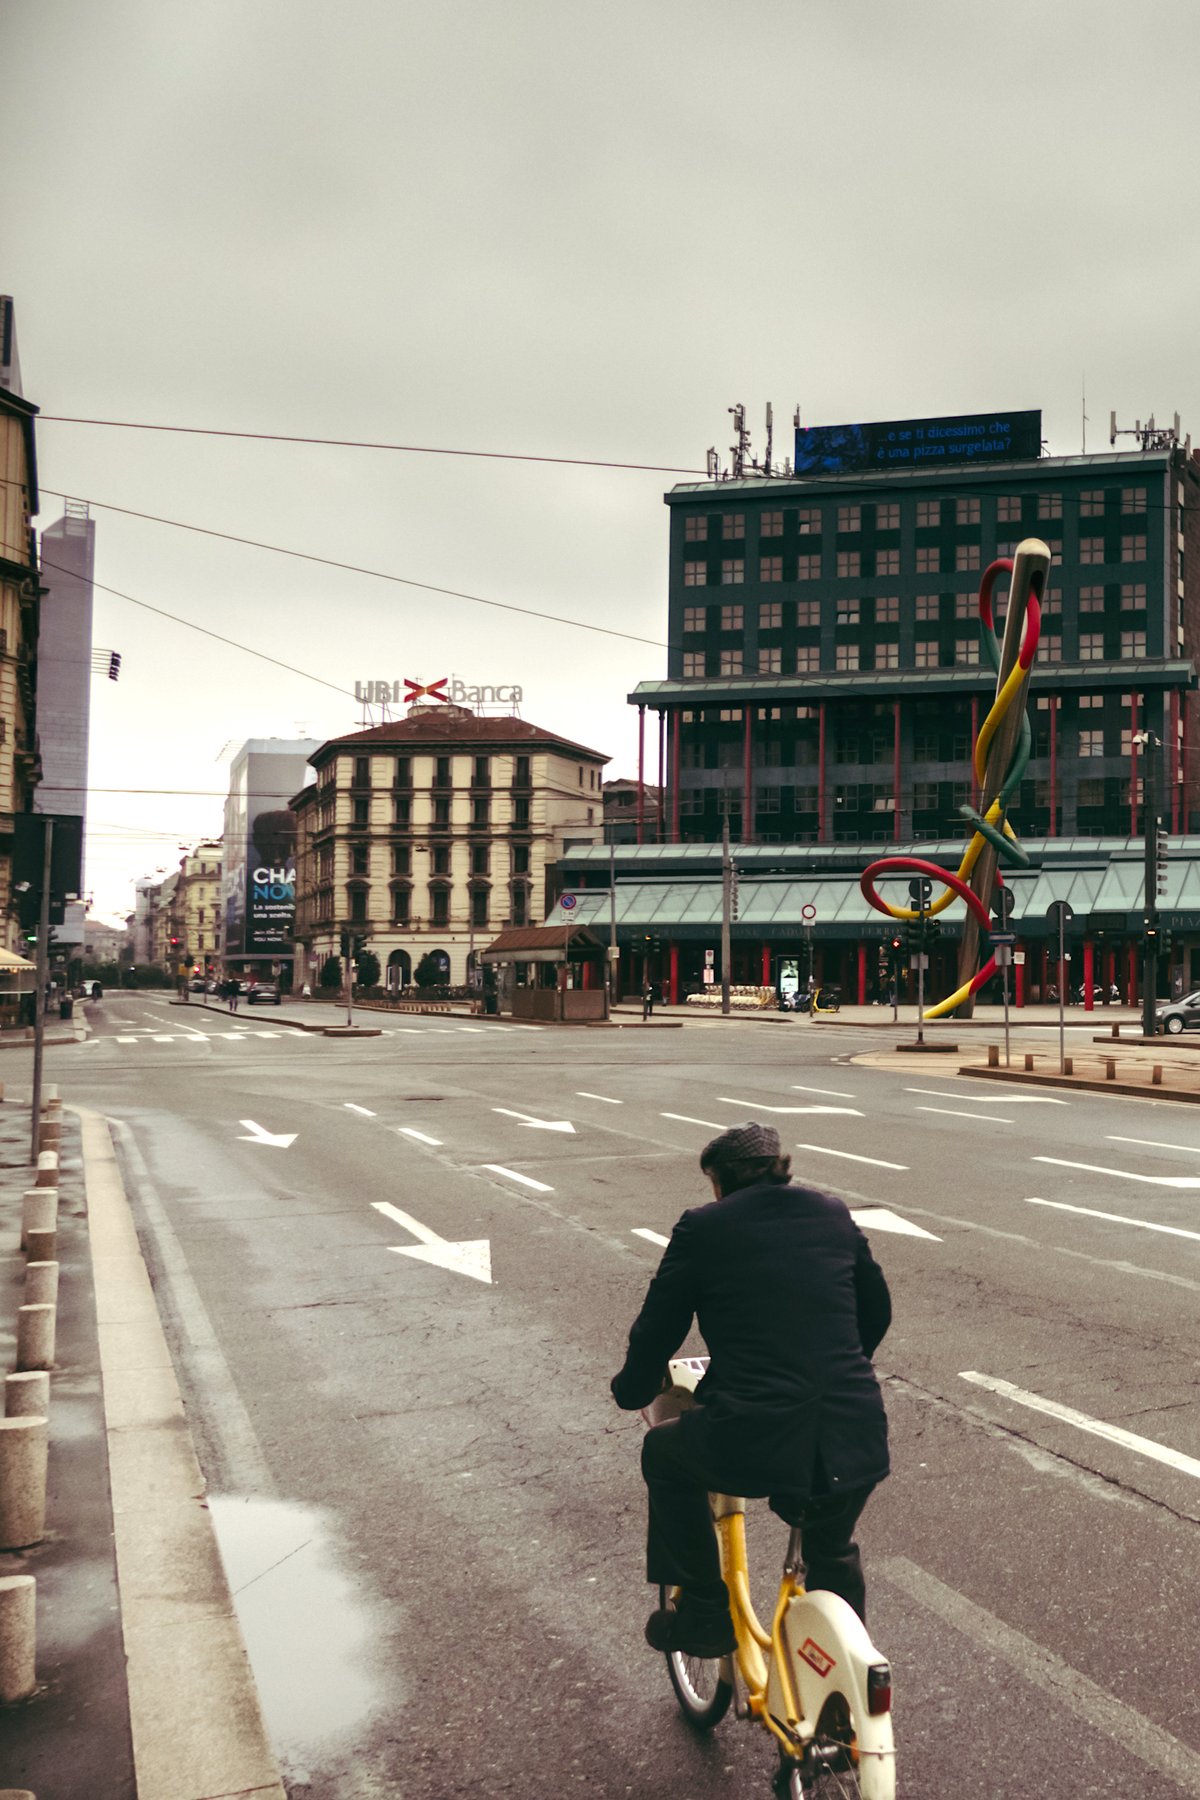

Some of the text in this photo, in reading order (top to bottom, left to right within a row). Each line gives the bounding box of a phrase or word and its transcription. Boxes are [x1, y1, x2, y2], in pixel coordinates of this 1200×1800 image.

[898, 431, 912, 440] se
[916, 428, 924, 439] ti
[928, 424, 985, 438] dicessimo
[989, 421, 1010, 434] che
[889, 447, 909, 458] una
[913, 444, 945, 461] pizza
[948, 437, 1011, 456] surgelata?
[354, 680, 522, 702] UBI Banca
[253, 868, 296, 884] CHA
